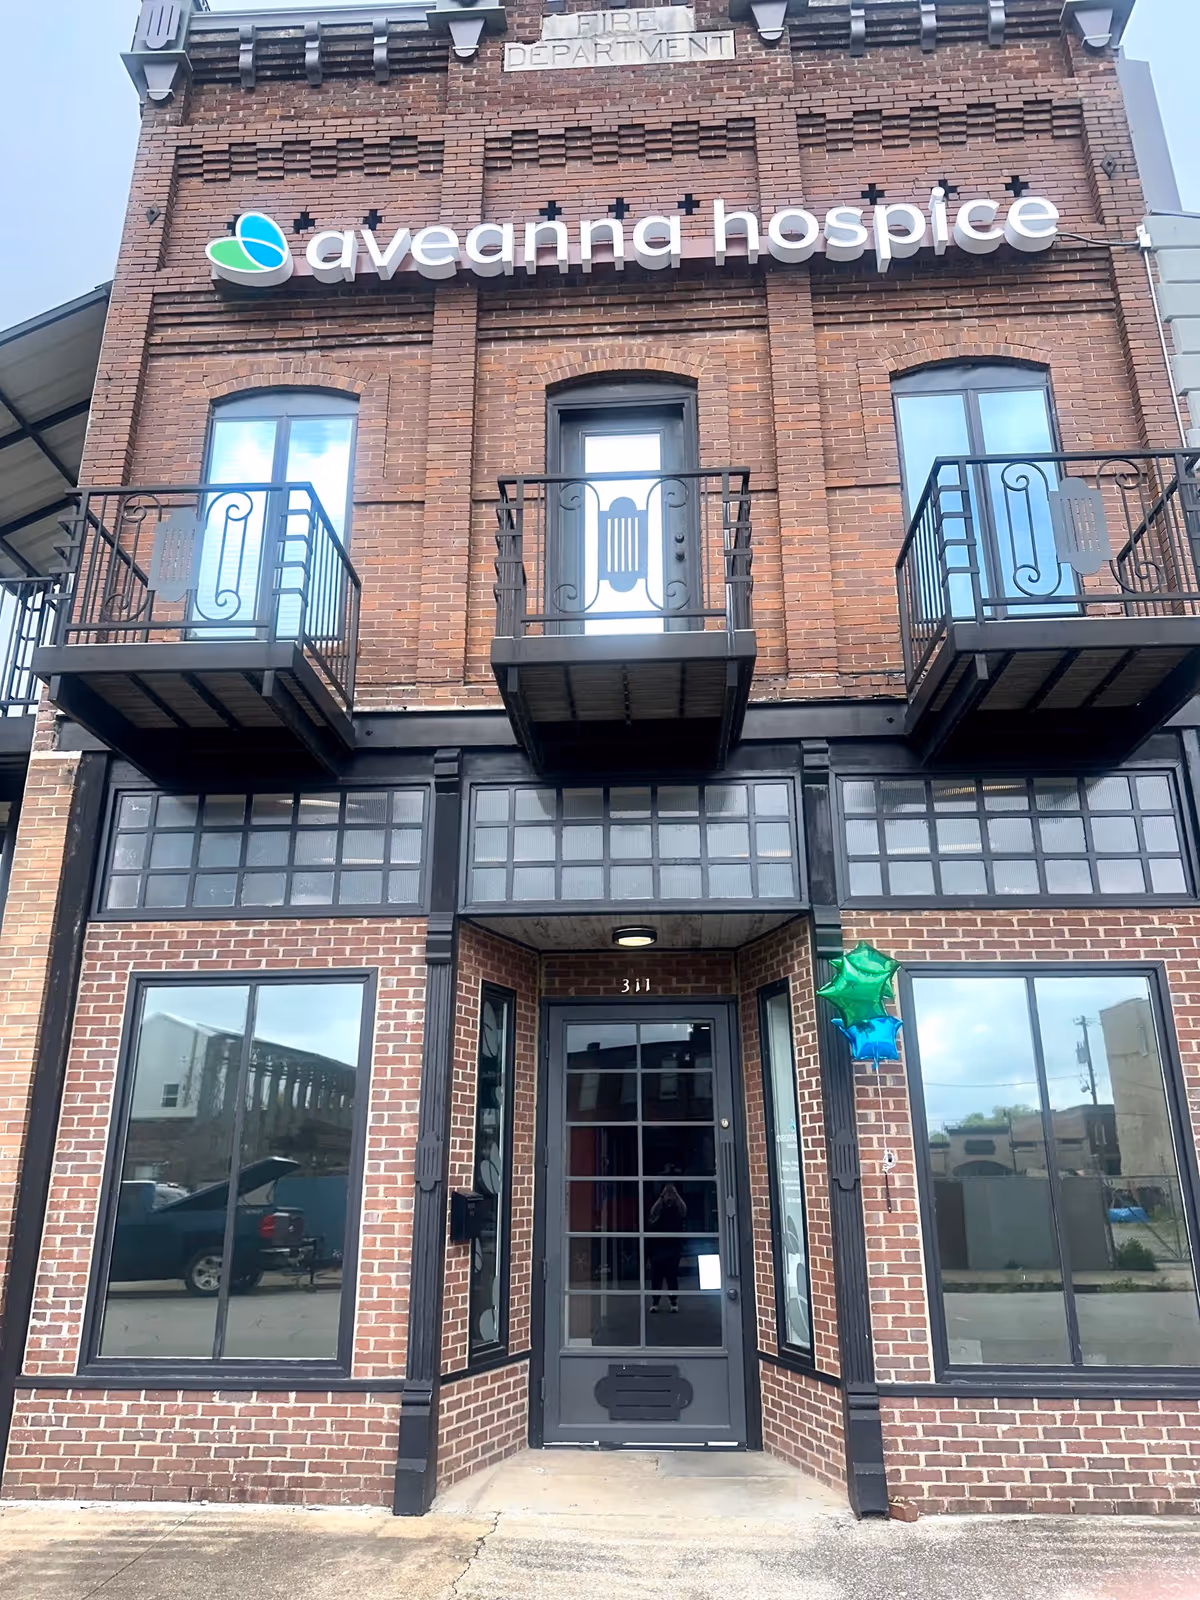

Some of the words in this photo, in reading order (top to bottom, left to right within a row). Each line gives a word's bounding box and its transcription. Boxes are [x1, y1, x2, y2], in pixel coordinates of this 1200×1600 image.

[577, 10, 657, 35] FIRE
[507, 36, 730, 67] DEPARTMENT
[306, 215, 681, 284] aveanna
[714, 186, 1059, 273] hospice
[621, 978, 650, 993] 311
